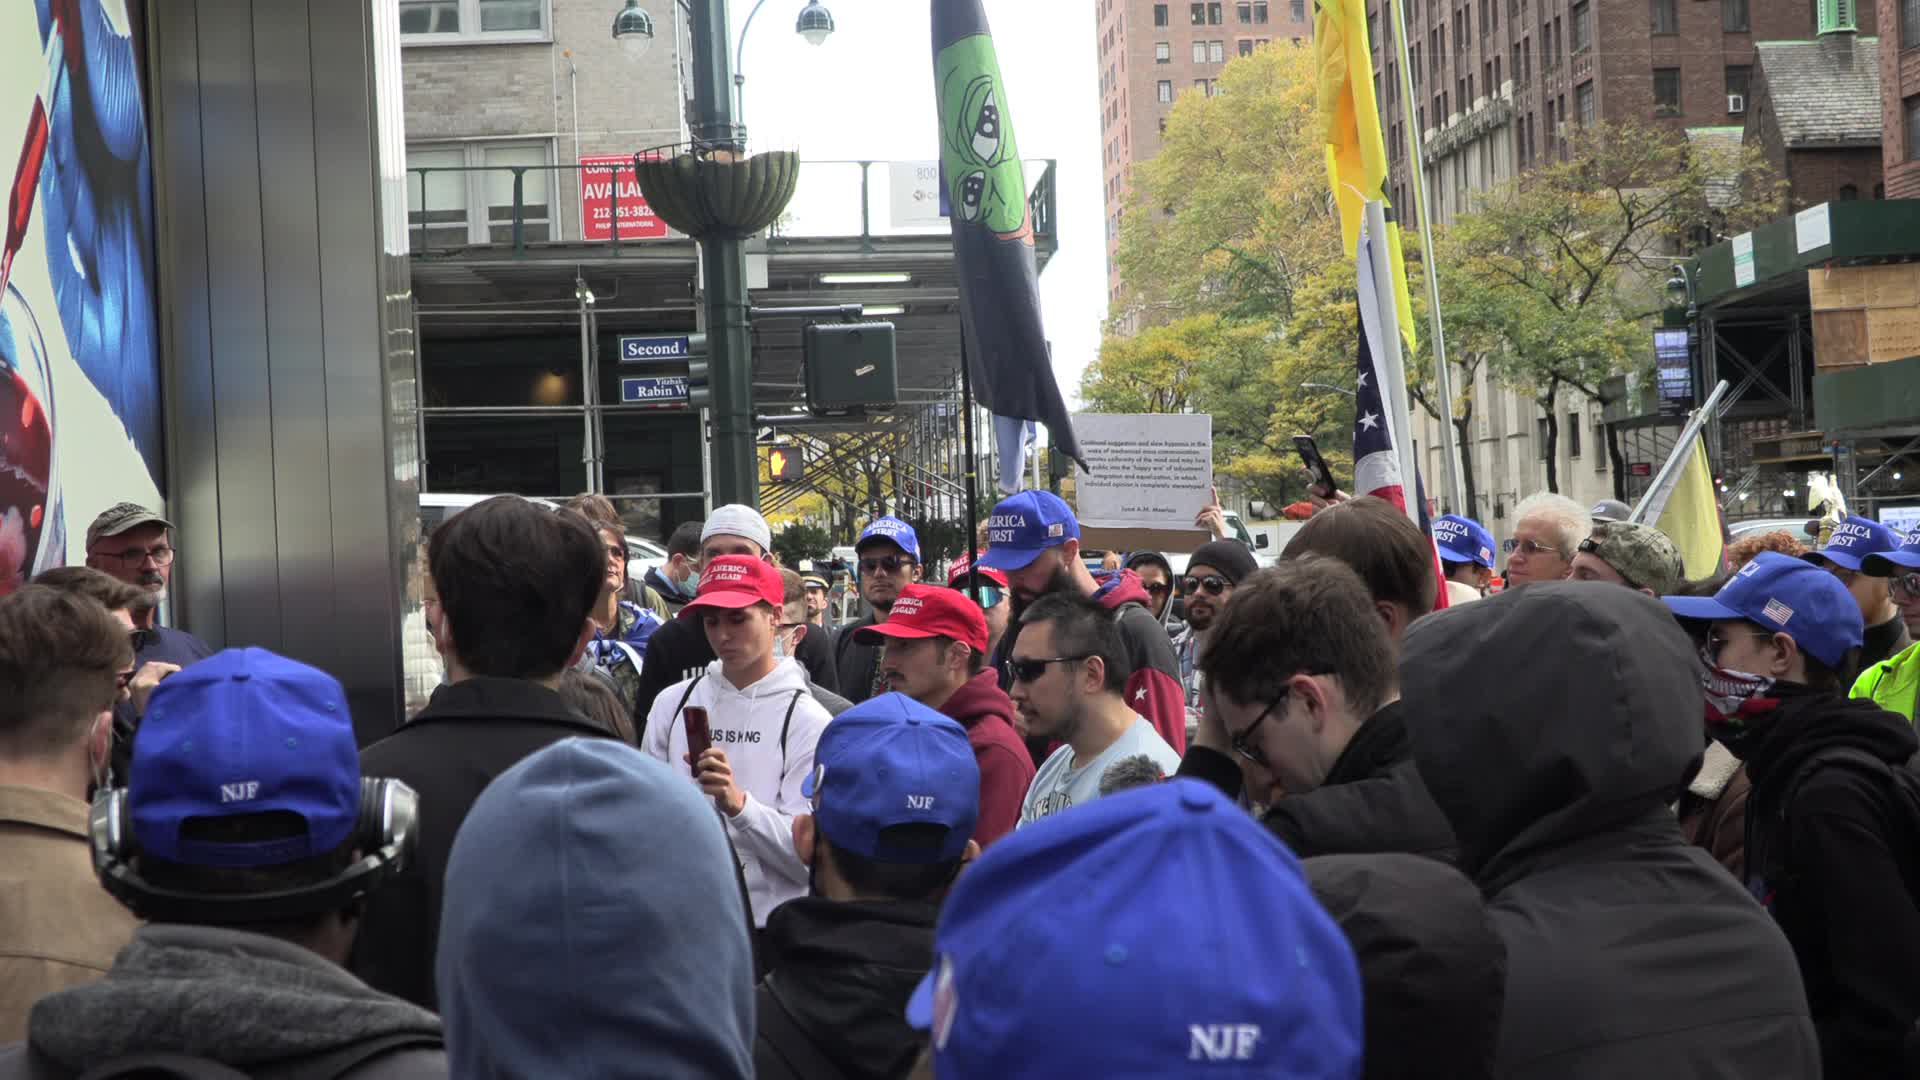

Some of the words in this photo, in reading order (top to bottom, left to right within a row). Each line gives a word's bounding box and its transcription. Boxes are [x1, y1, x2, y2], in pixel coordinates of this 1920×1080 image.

[628, 341, 679, 356] Second
[638, 386, 673, 398] Rabin
[989, 514, 1026, 529] ERICA
[1435, 520, 1469, 537] ERICA
[990, 529, 1015, 543] IRST
[725, 730, 736, 743] IS
[220, 781, 260, 803] NJF
[906, 794, 935, 811] NJF
[1188, 1023, 1261, 1061] NJF
